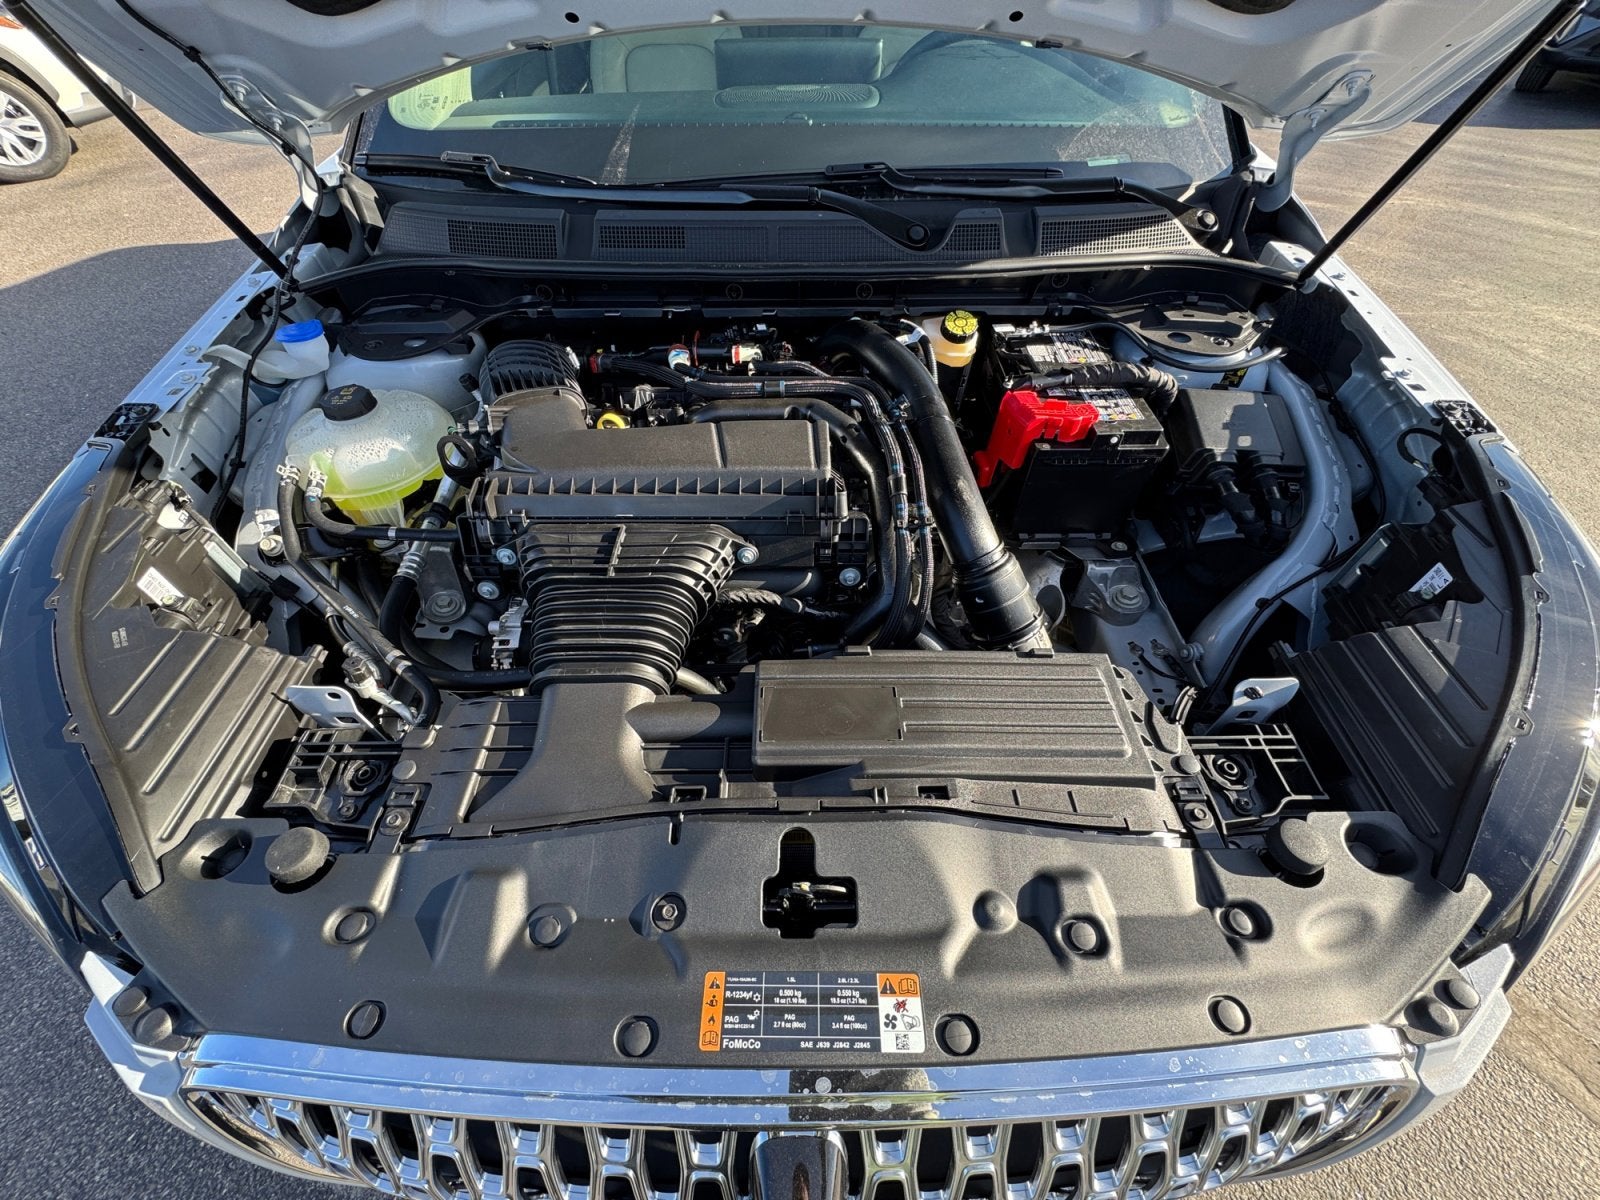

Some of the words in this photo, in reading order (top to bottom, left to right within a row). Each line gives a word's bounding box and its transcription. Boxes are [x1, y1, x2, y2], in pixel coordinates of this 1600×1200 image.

[725, 990, 753, 999] R-1234yf
[794, 989, 802, 998] kg
[852, 989, 859, 997] kg
[722, 1038, 761, 1049] FoMoCo
